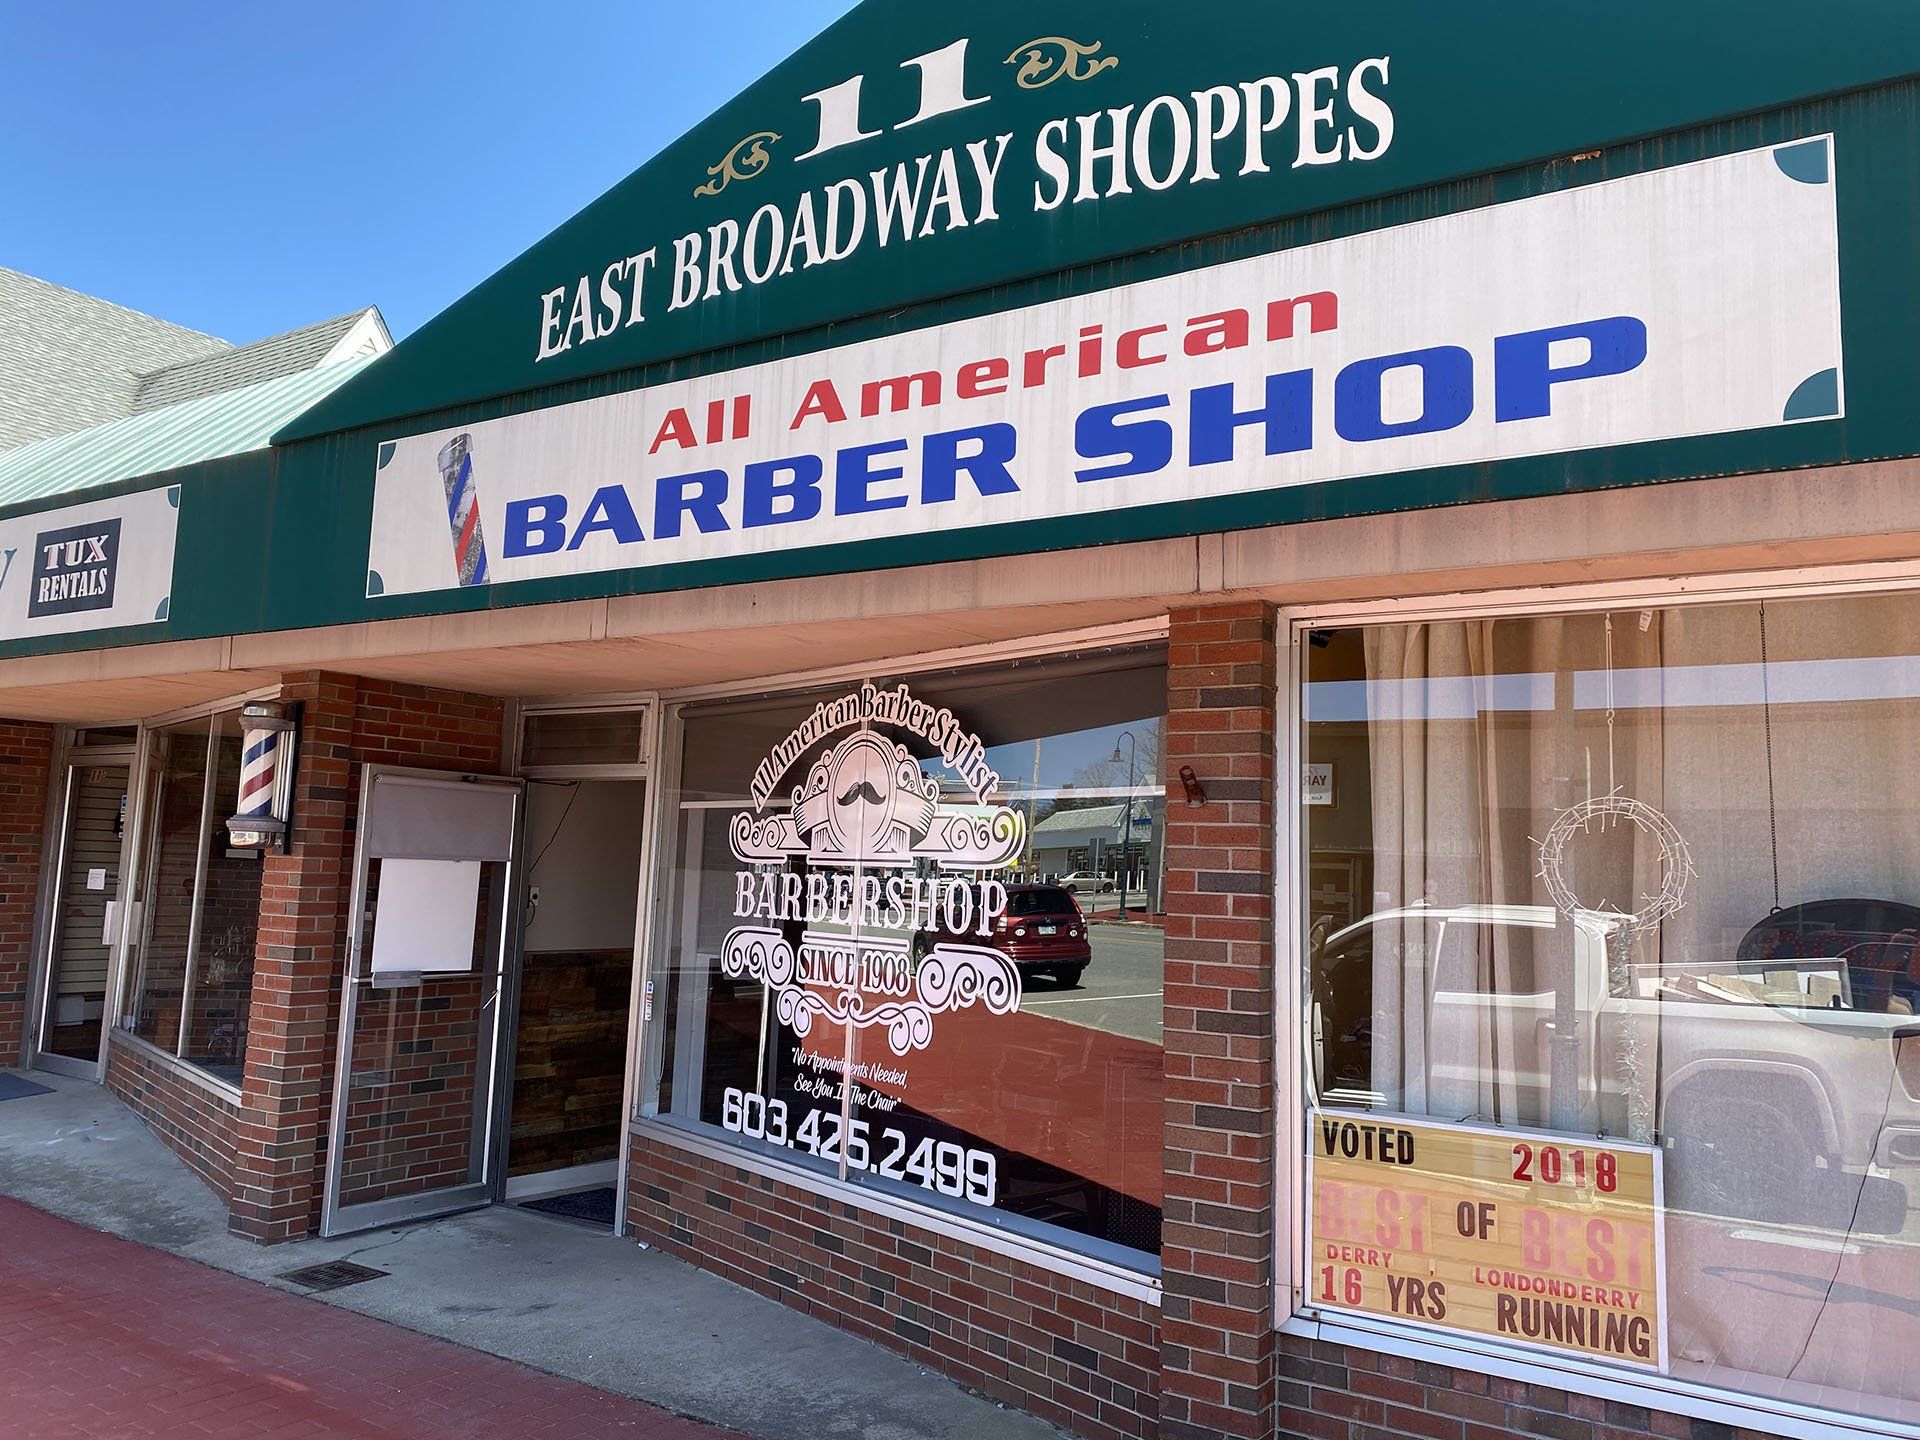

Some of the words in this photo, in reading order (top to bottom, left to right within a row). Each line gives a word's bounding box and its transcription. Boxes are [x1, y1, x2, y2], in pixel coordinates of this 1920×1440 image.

[794, 38, 991, 162] 11
[535, 246, 657, 363] EAST
[667, 132, 1014, 313] BROADWAY
[1033, 56, 1395, 212] SHOPPES
[648, 394, 751, 455] All
[789, 290, 1338, 430] American
[502, 422, 1022, 559] BARBER
[1073, 316, 1648, 483] SHOP
[37, 567, 108, 603] RENTALS
[43, 534, 109, 570] TUX
[770, 692, 862, 775] American
[860, 684, 935, 738] Barber
[930, 708, 1002, 808] Stylist
[733, 870, 1008, 937] BARBERSHOP
[798, 946, 857, 988] SINCE
[861, 948, 911, 997] 1908
[794, 1073, 813, 1093] See
[811, 1078, 834, 1099] You
[851, 1085, 866, 1106] The
[722, 1086, 997, 1207] 603.425.2499
[1322, 1120, 1415, 1165] VOTED
[1512, 1143, 1617, 1193] 2018
[1319, 1180, 1428, 1251] BEST
[1457, 1200, 1496, 1240] OF
[1523, 1208, 1650, 1288] BEST
[1326, 1244, 1392, 1268] DERRY
[1475, 1267, 1640, 1311] LONDONDERRY
[1321, 1265, 1362, 1305] 16
[1387, 1274, 1446, 1320] YRS
[1497, 1293, 1651, 1359] RUNNING
